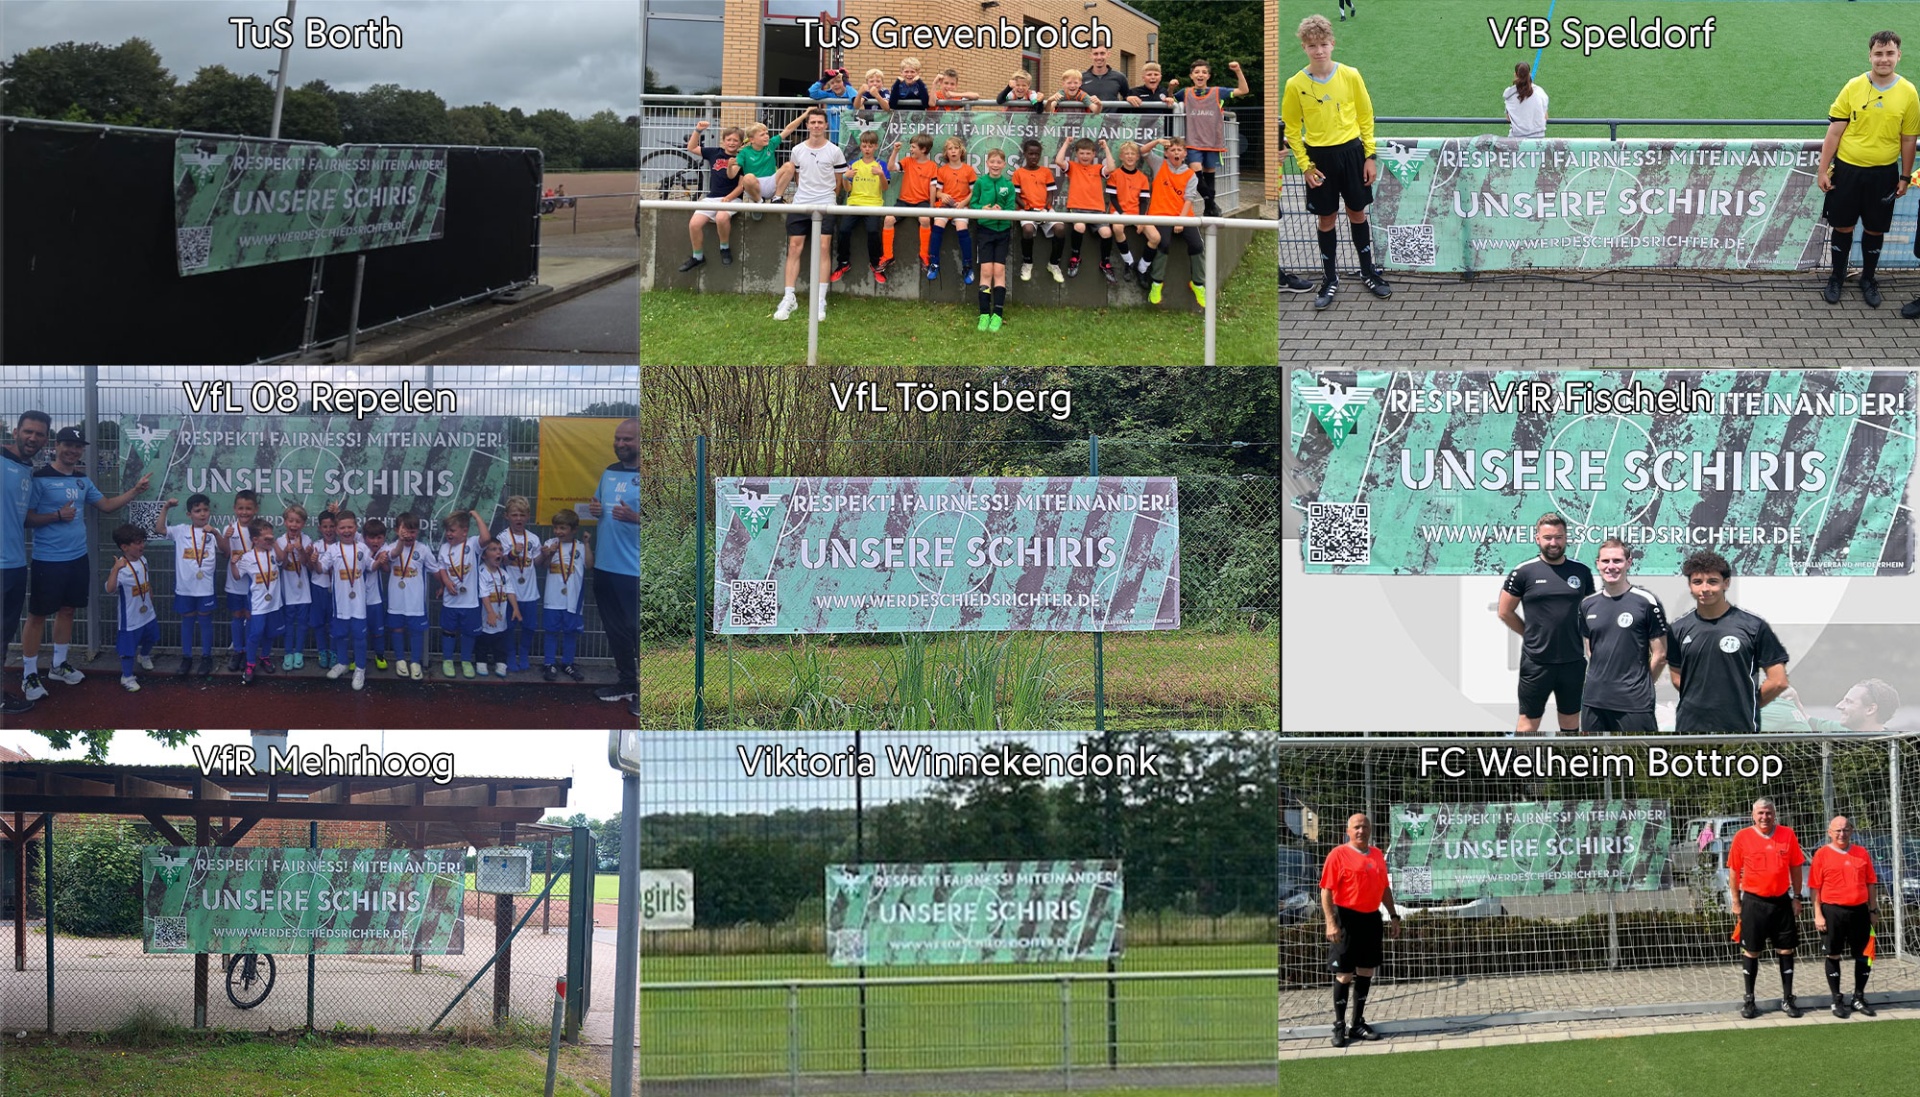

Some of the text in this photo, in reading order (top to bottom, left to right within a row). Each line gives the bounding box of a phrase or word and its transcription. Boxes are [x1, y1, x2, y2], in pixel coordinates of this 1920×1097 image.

[889, 122, 1158, 140] RESPEKT! FAIRNESS! MITEINANDER!
[233, 156, 443, 171] RESPEKT! FAIRNESS! MITEINANDER!
[1443, 151, 1546, 168] RESPEKT!
[1553, 150, 1662, 168] FAIRNESS!
[232, 186, 418, 216] UNSERE SCHIRIS
[1453, 188, 1768, 219] UNSERE SCHIRIS
[239, 221, 406, 248] WWW.WERDESCHIEDSRICHTER.DE
[1472, 235, 1746, 250] WWW.WERDESCHIEDSRICHTER.DE
[1390, 389, 1526, 414] RESPEK
[180, 431, 502, 448] RESPEKT! FAIRNESS! MITEINANDER!
[1400, 449, 1827, 492] UNSERE SCHIRIS
[186, 467, 454, 497] UNSERE SCHIRIS
[66, 488, 79, 499] SN
[794, 494, 1171, 512] RESPEKT! FAIRNESS! MITEINANDER!
[1421, 525, 1802, 545] WWW.WEESCHIEDSRICHTER.DE
[801, 536, 1117, 569] UNSERE SCHIRIS
[815, 593, 1100, 608] WWW.WERDESCHIEDSRICHTER.DE
[1439, 810, 1667, 825] RESPEKT! FAIRNESS! MITEINANDER!
[1444, 836, 1635, 860] UNSERE SCHIRIS
[197, 859, 461, 874] RESPEKT! FAIRNESS! MITEINANDER!
[1017, 872, 1117, 884] MITEINANDER!
[202, 889, 420, 912] UNSERE SCHIRIS
[640, 882, 686, 919] girls
[880, 900, 1082, 923] UNSERE SCHIRIS
[213, 928, 408, 939] WWW.WERDESCHIEDSRICHTER.DE
